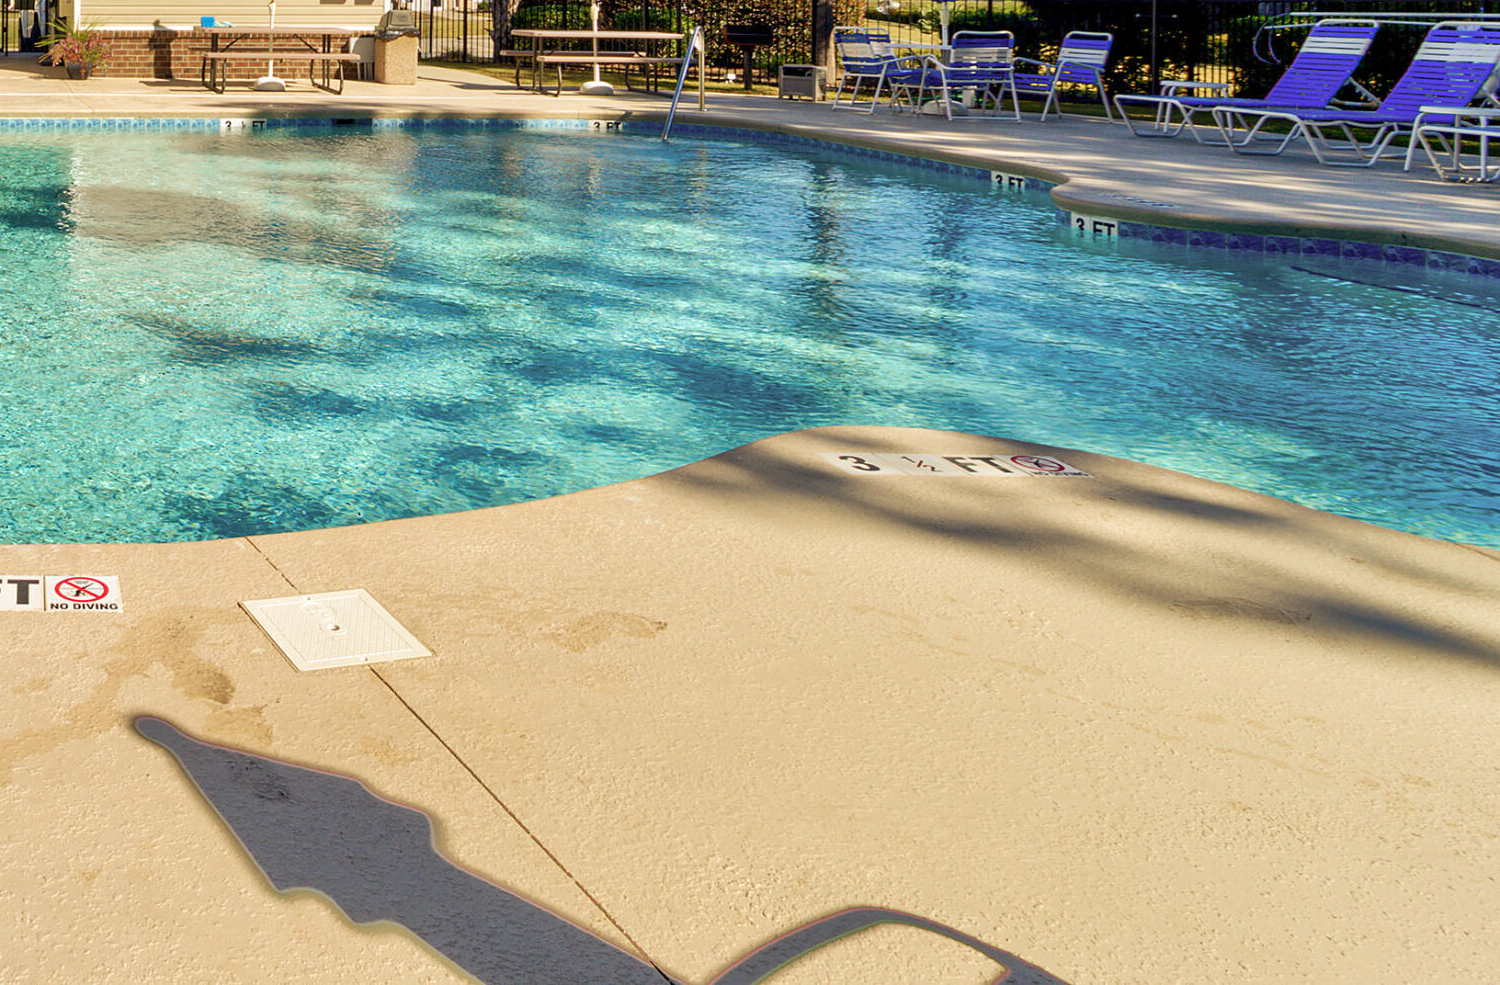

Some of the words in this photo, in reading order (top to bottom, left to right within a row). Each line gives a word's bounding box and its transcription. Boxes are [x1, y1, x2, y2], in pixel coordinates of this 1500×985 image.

[1008, 176, 1024, 188] FT
[1076, 218, 1085, 231] 3
[1093, 220, 1115, 237] FT
[838, 455, 881, 472] 3
[941, 456, 1013, 474] FT
